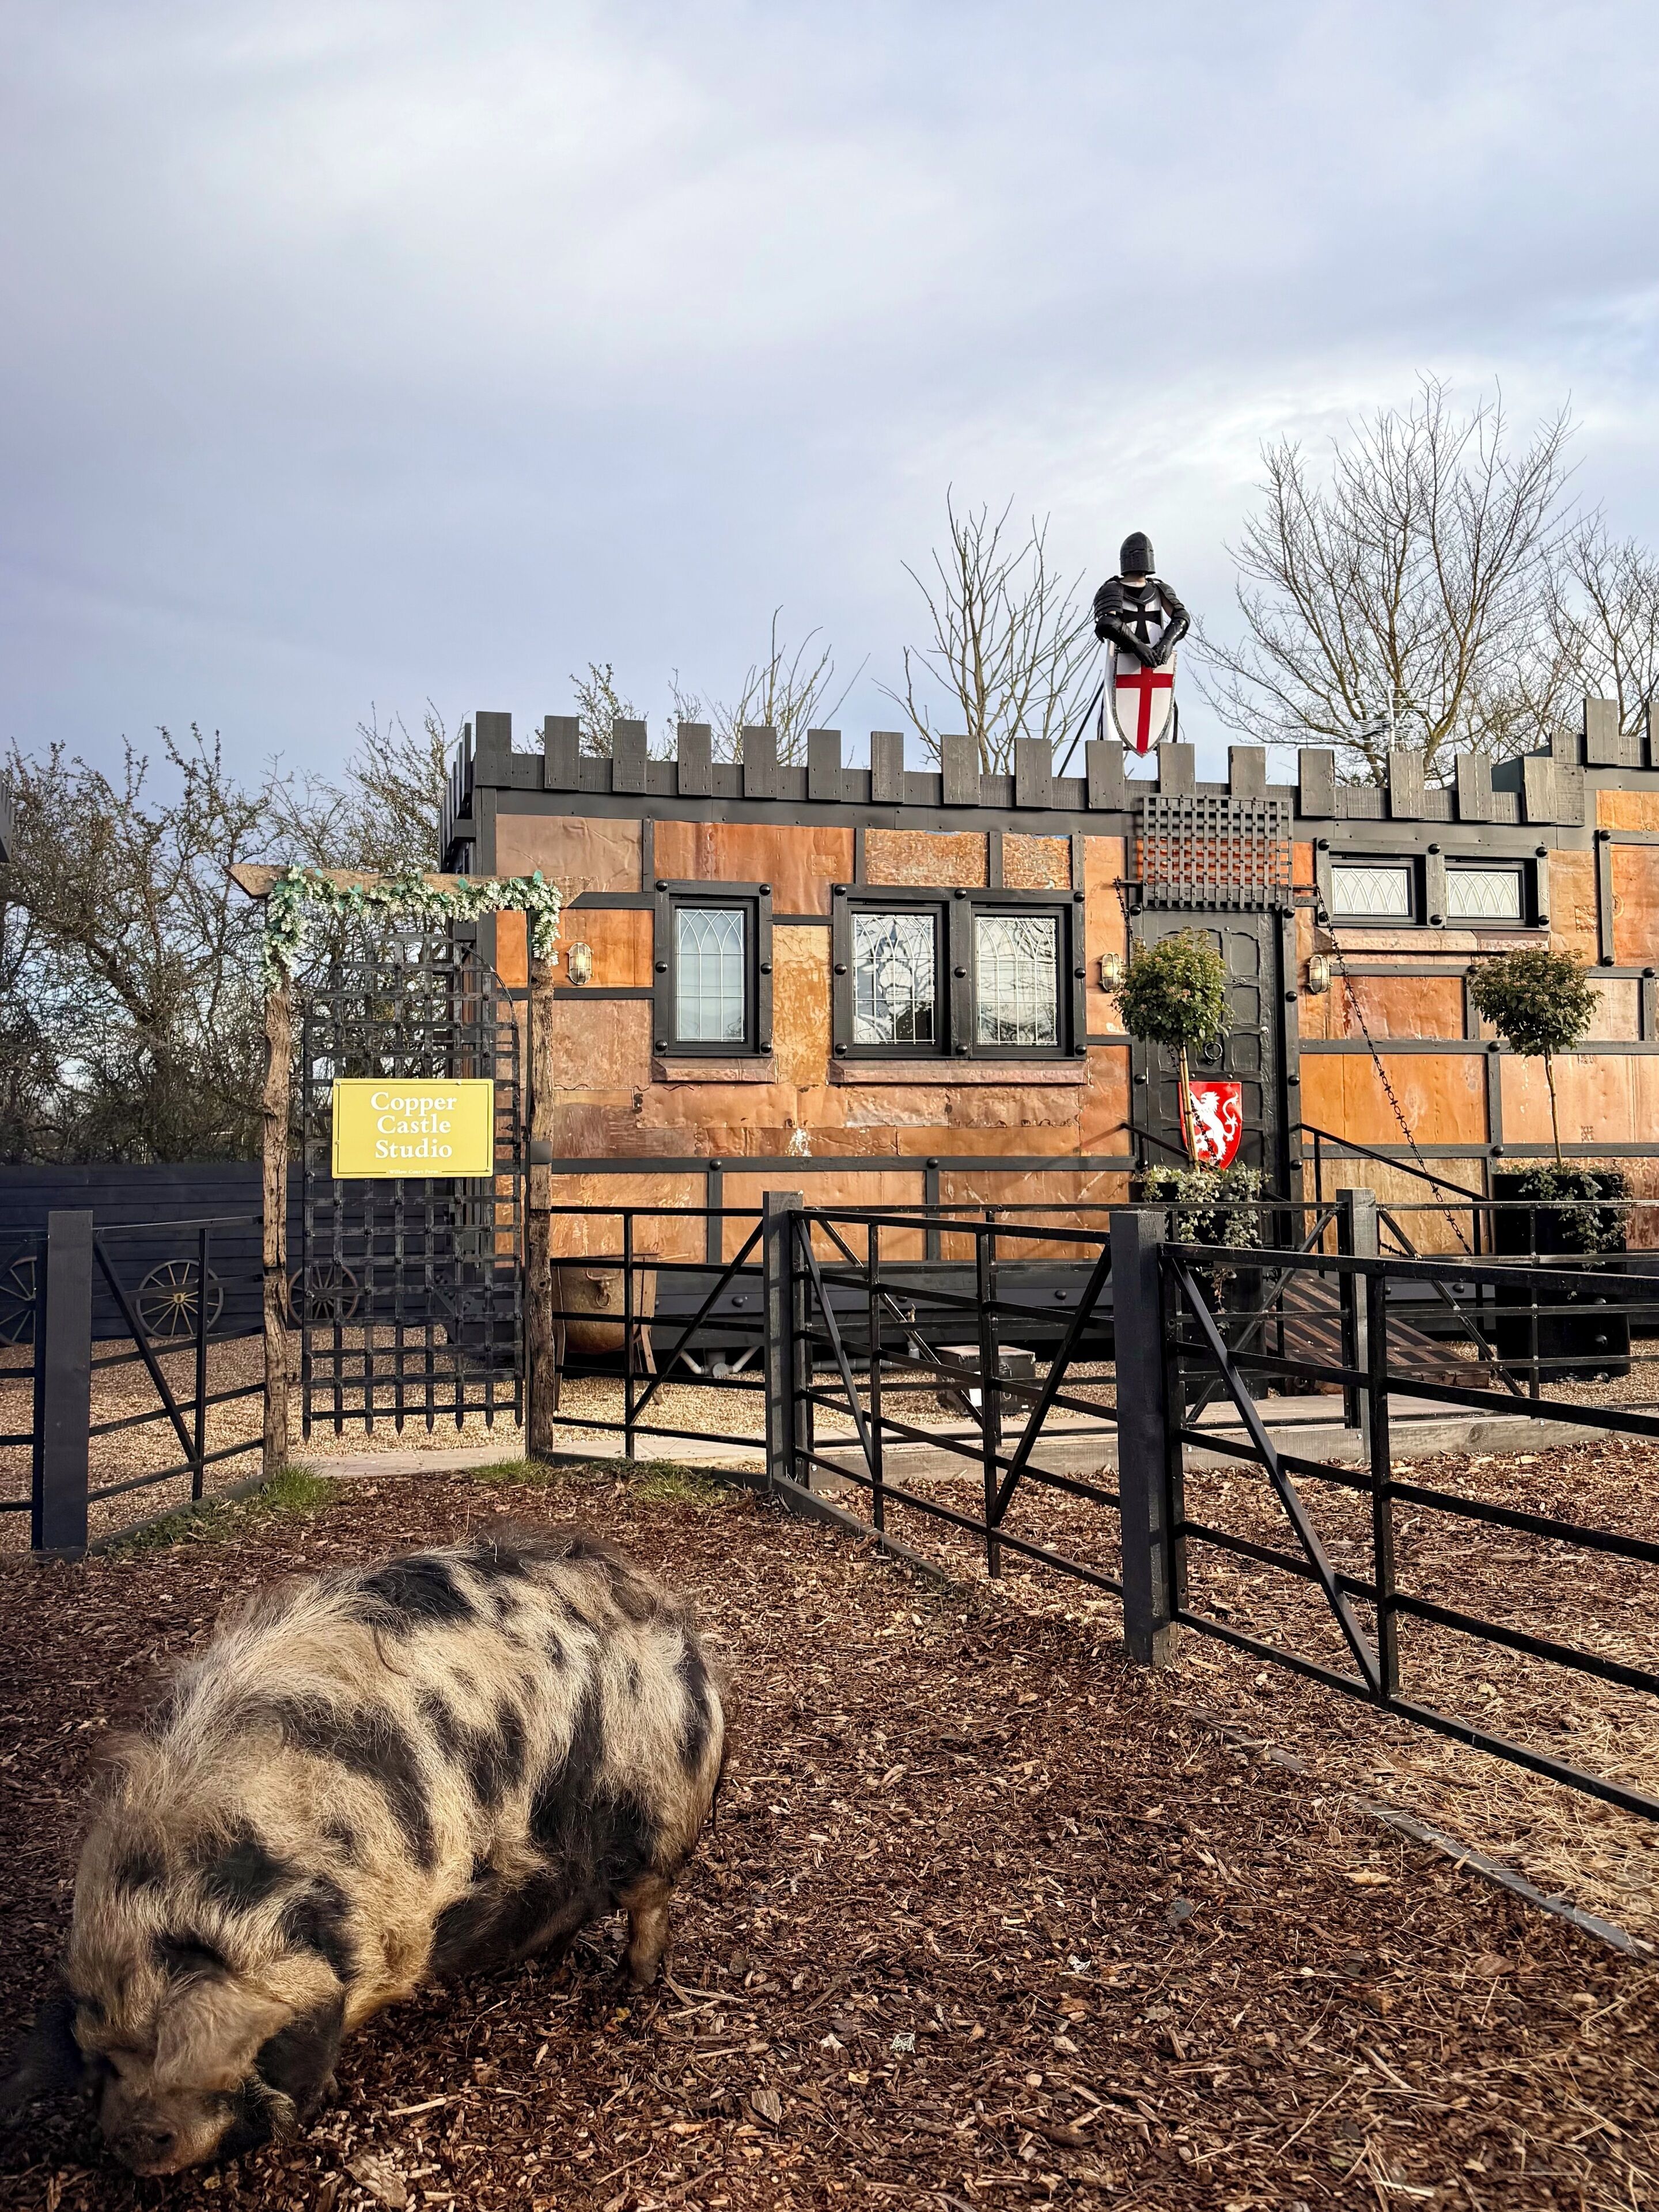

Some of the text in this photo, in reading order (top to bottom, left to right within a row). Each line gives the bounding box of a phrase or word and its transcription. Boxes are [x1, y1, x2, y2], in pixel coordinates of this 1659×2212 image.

[370, 1091, 457, 1116] Copper
[377, 1113, 451, 1134] Castle
[375, 1137, 452, 1158] Studio
